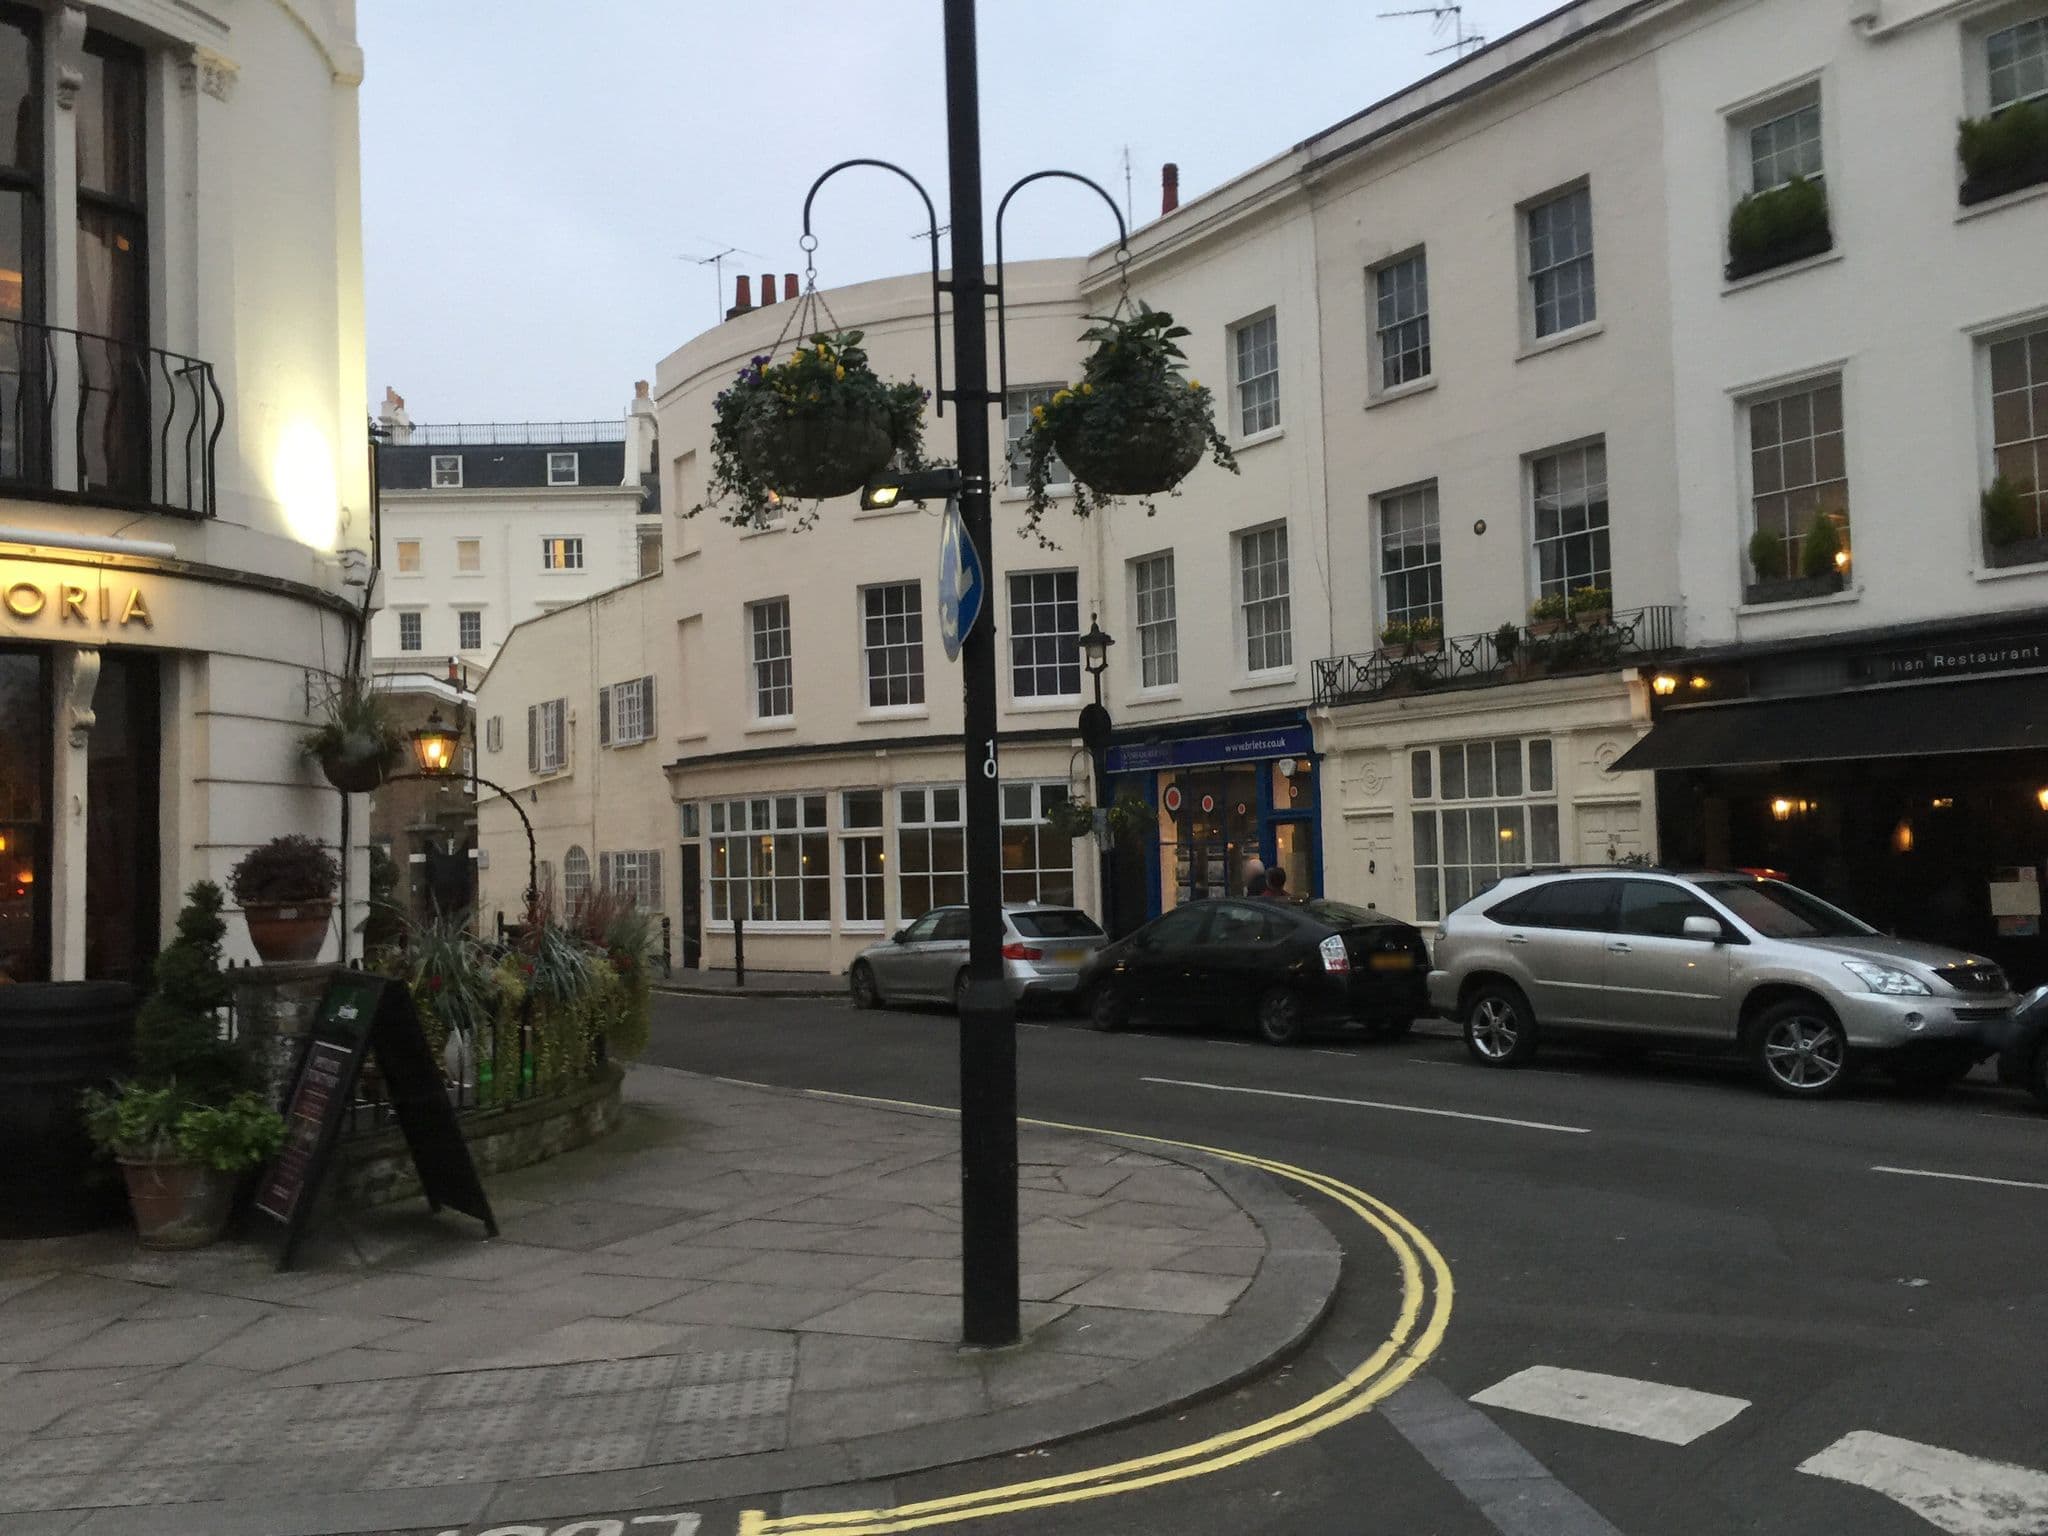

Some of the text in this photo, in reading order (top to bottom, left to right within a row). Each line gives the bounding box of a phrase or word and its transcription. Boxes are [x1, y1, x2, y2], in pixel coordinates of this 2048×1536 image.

[3, 582, 154, 629] ORIA
[1933, 646, 2040, 667] Restaurant
[983, 738, 997, 778] 10
